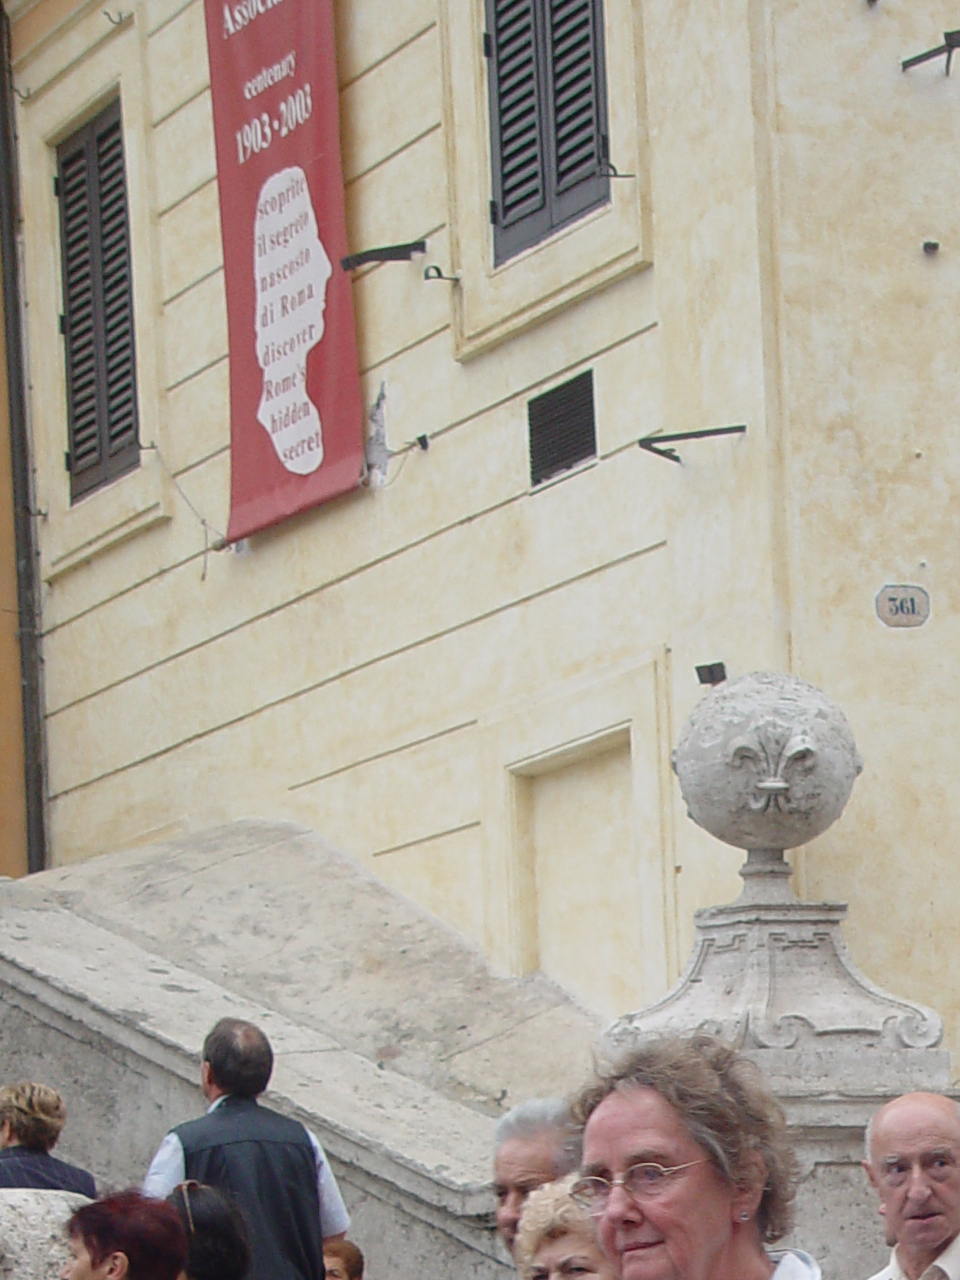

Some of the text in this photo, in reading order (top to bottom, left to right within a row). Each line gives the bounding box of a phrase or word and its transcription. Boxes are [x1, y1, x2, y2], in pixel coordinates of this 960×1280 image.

[243, 50, 296, 100] centenary
[258, 177, 306, 220] scoprite
[258, 211, 309, 258] il segreto
[260, 247, 311, 293] nascosto
[261, 283, 314, 328] di Roma
[262, 323, 315, 367] discover
[264, 364, 306, 402] Rome's
[270, 400, 310, 435] hidden
[282, 431, 320, 463] secret
